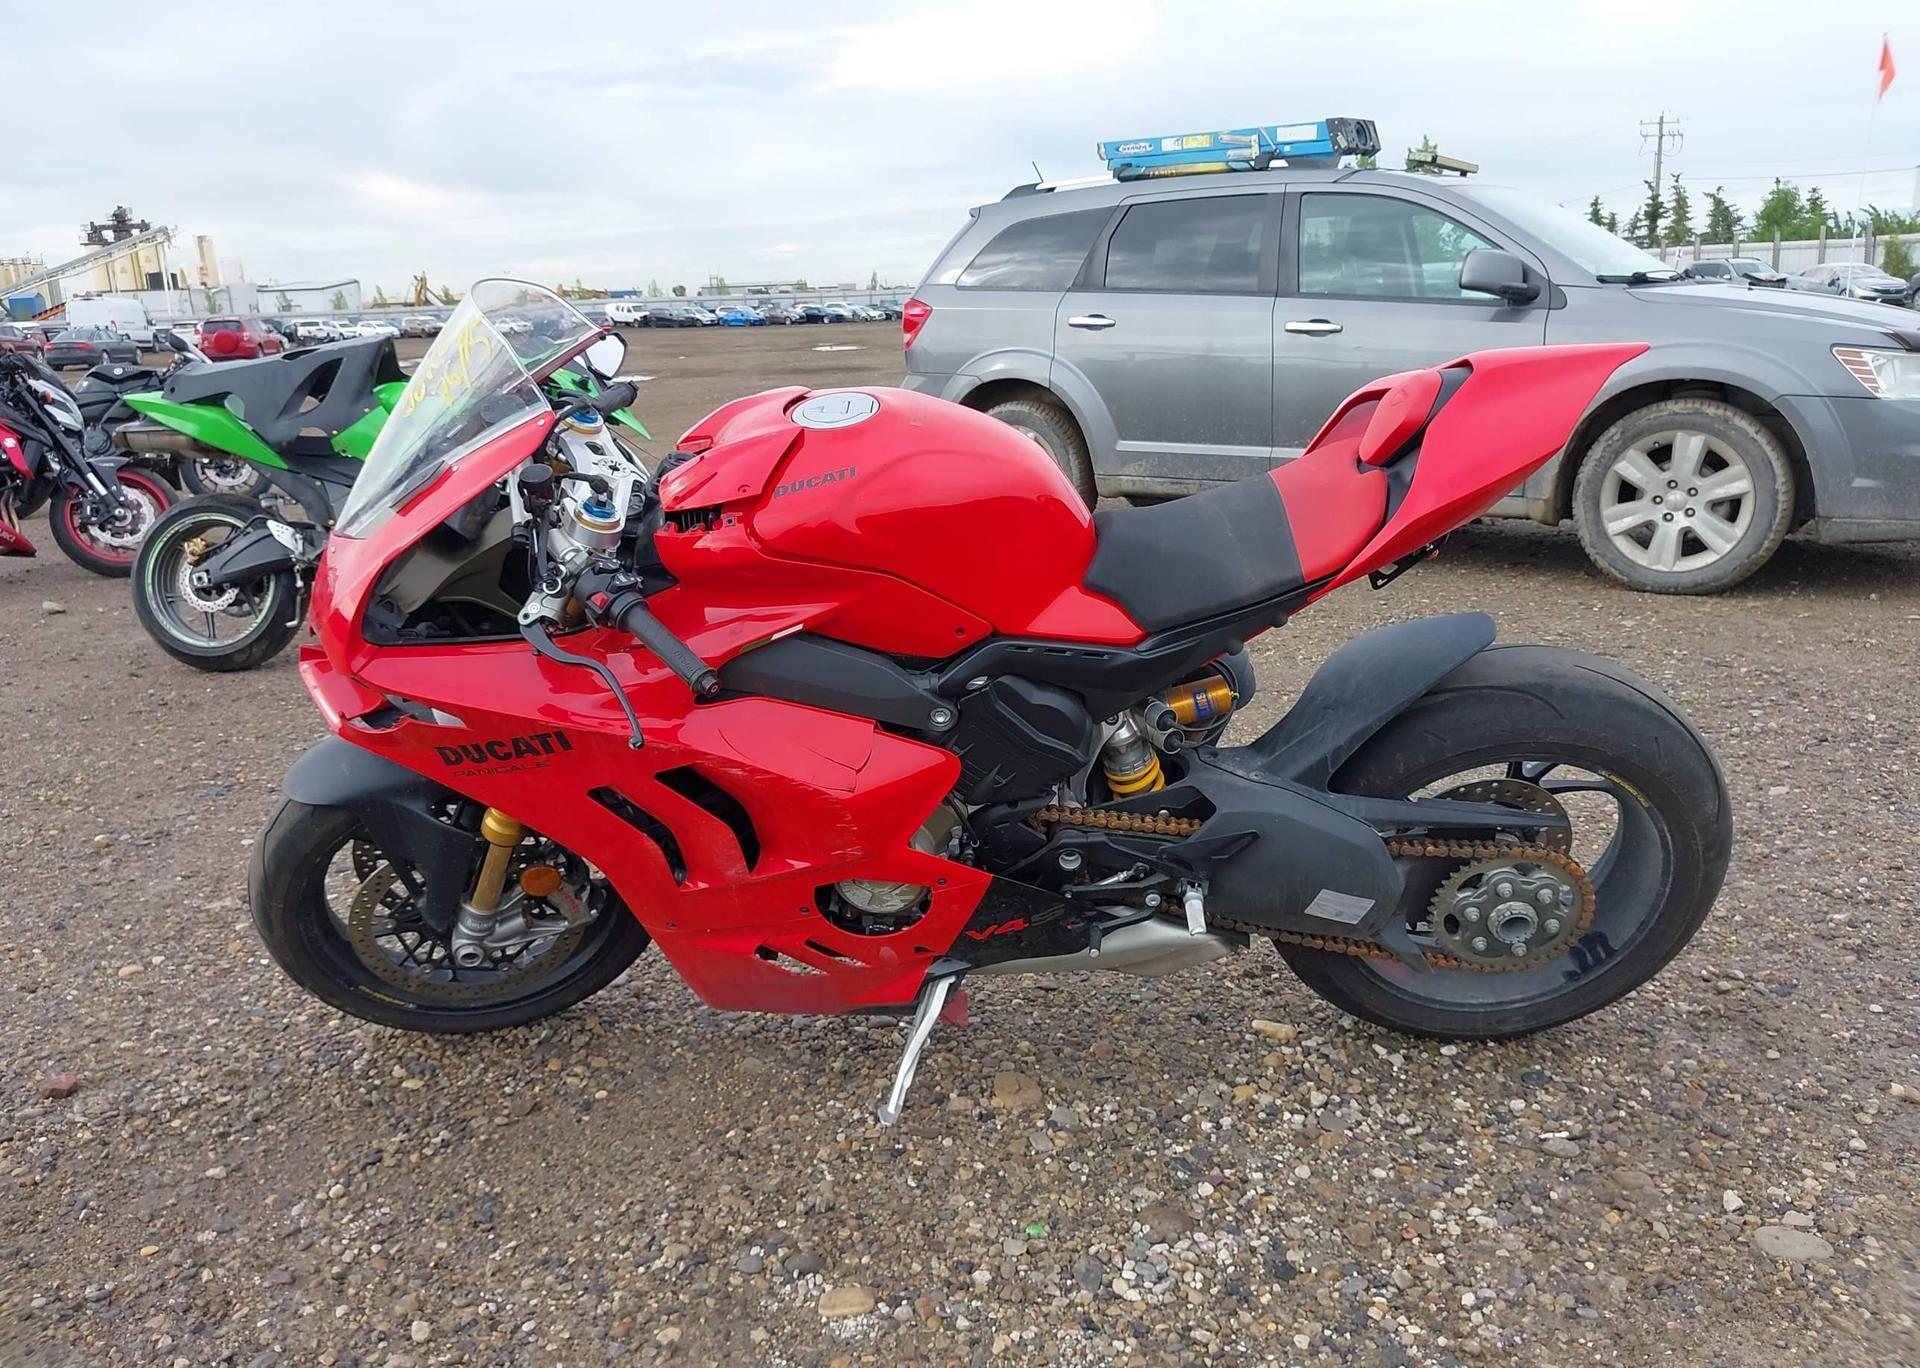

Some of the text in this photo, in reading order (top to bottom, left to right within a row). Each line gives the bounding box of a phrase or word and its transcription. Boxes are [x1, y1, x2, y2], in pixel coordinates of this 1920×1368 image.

[774, 466, 857, 498] DUCATI
[435, 730, 575, 766] DUCATI
[966, 918, 1030, 940] V4
